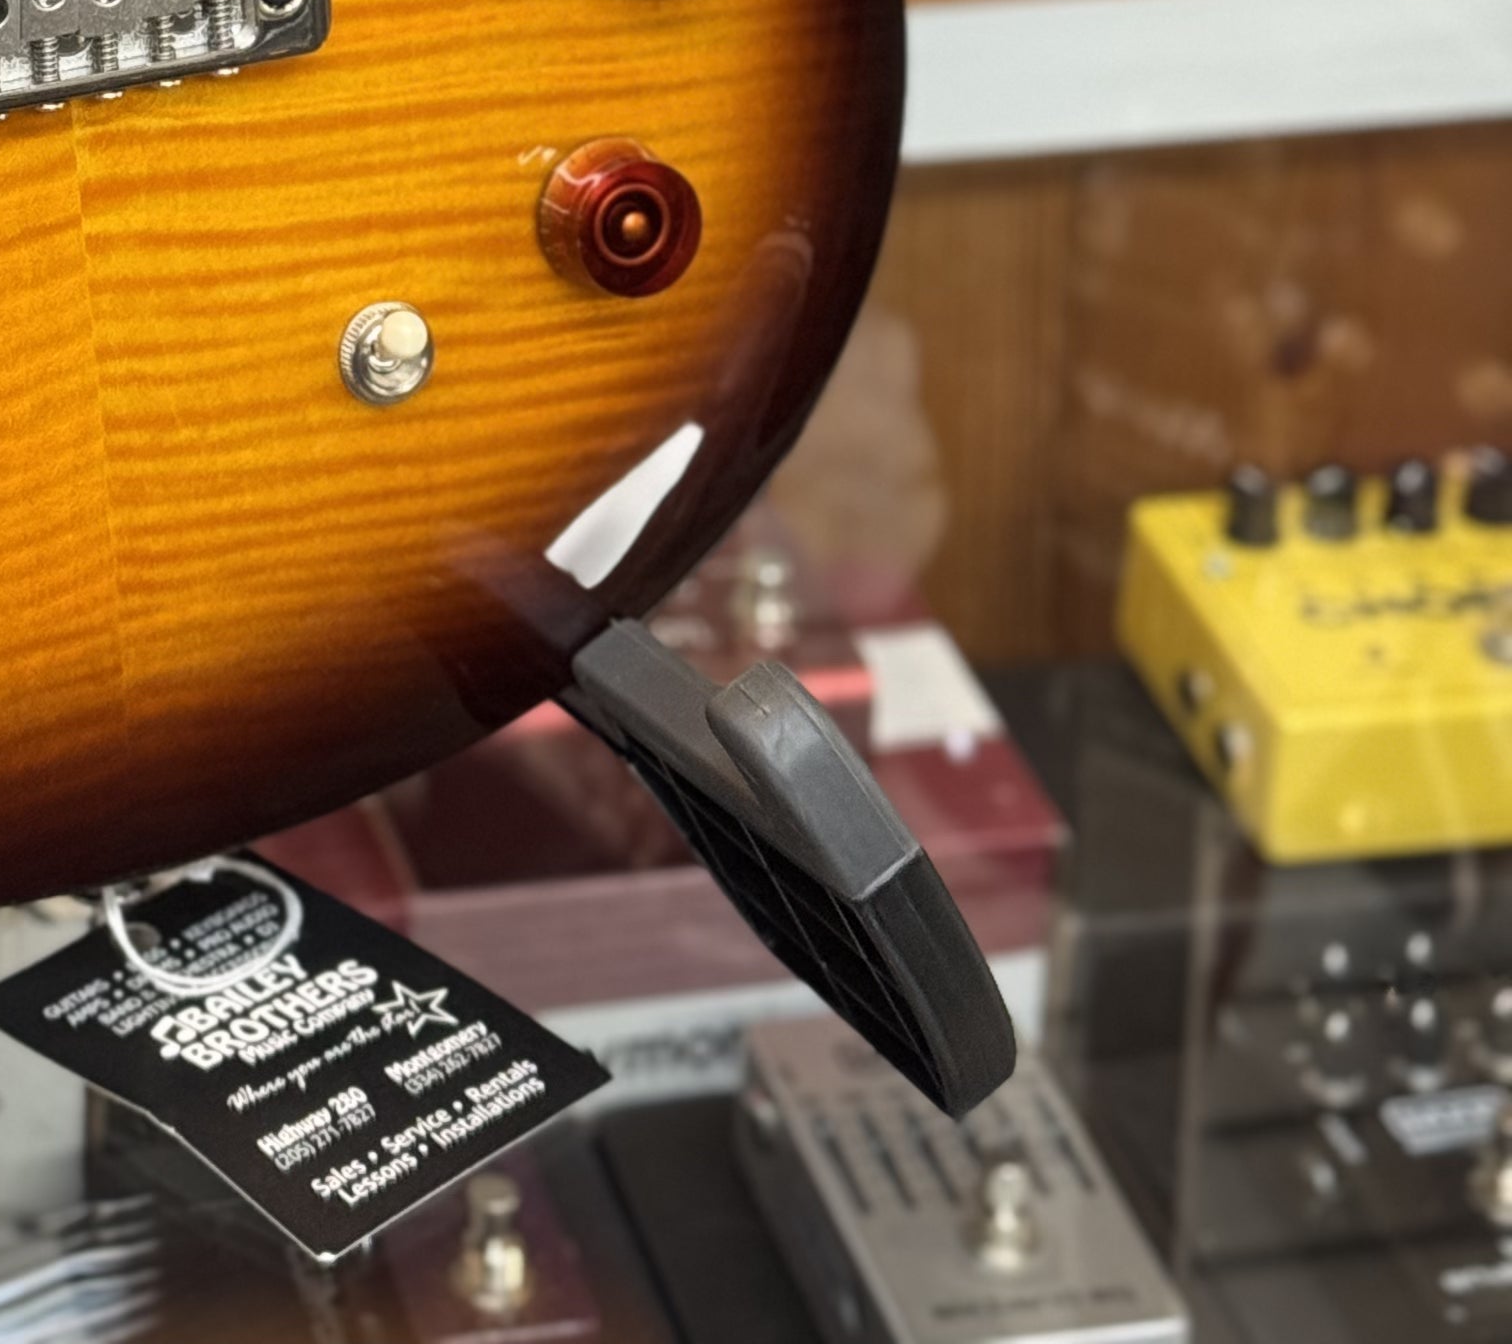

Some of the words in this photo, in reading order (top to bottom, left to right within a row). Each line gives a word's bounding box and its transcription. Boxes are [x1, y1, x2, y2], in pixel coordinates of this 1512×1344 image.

[177, 954, 308, 1027] BAILEY
[180, 959, 378, 1071] BROTHERS
[238, 1030, 298, 1065] Music
[293, 988, 375, 1036] Company
[227, 1077, 286, 1111] Where
[287, 1057, 322, 1092] you
[324, 1040, 352, 1062] are
[347, 1025, 382, 1049] the
[384, 1020, 488, 1085] Montgomery
[403, 1067, 445, 1095] (334)
[439, 1032, 503, 1077] 262-7827
[257, 1106, 332, 1158] Highway
[328, 1086, 368, 1117] 280
[274, 1142, 317, 1173] (205)
[312, 1103, 377, 1149] 271-7827
[311, 1159, 367, 1199] Sales
[380, 1108, 453, 1154] Service
[464, 1059, 539, 1104] Rentals
[338, 1152, 419, 1207] Lessons
[431, 1076, 547, 1150] Installations
